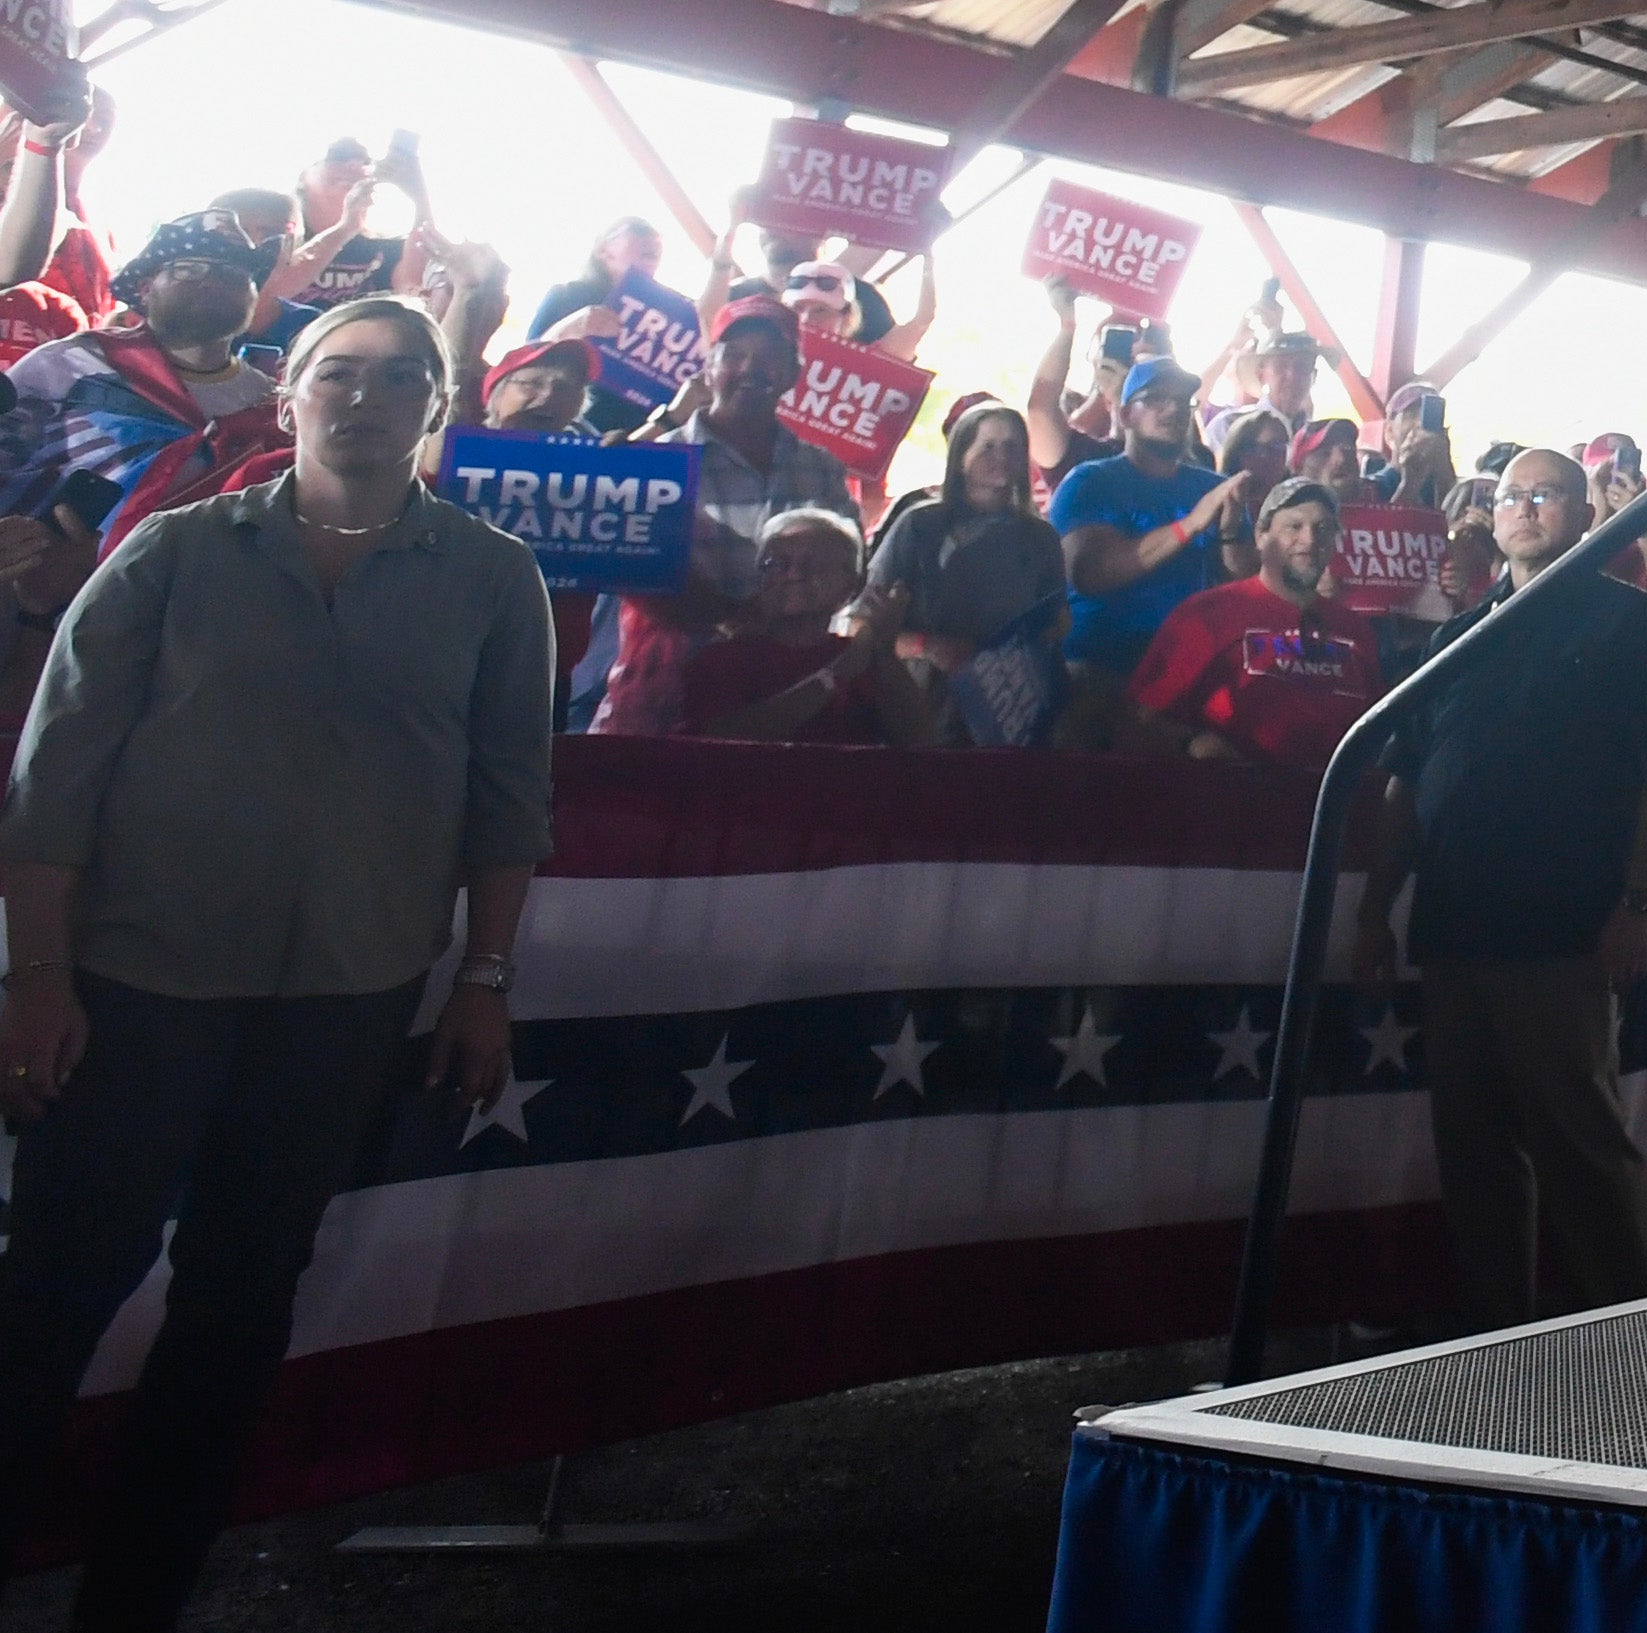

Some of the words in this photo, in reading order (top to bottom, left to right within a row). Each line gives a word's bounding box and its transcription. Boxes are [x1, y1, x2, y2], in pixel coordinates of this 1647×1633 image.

[772, 143, 938, 194] TRUMP
[788, 172, 914, 215] VANCE
[1043, 201, 1187, 264] TRUMP
[1049, 230, 1161, 284] VANCE
[617, 328, 700, 382] VANC
[799, 356, 911, 417] UMP
[778, 387, 880, 437] ANCE
[457, 467, 682, 514] TRUMP
[480, 506, 654, 543] VANCE
[1346, 555, 1439, 582] VANCE
